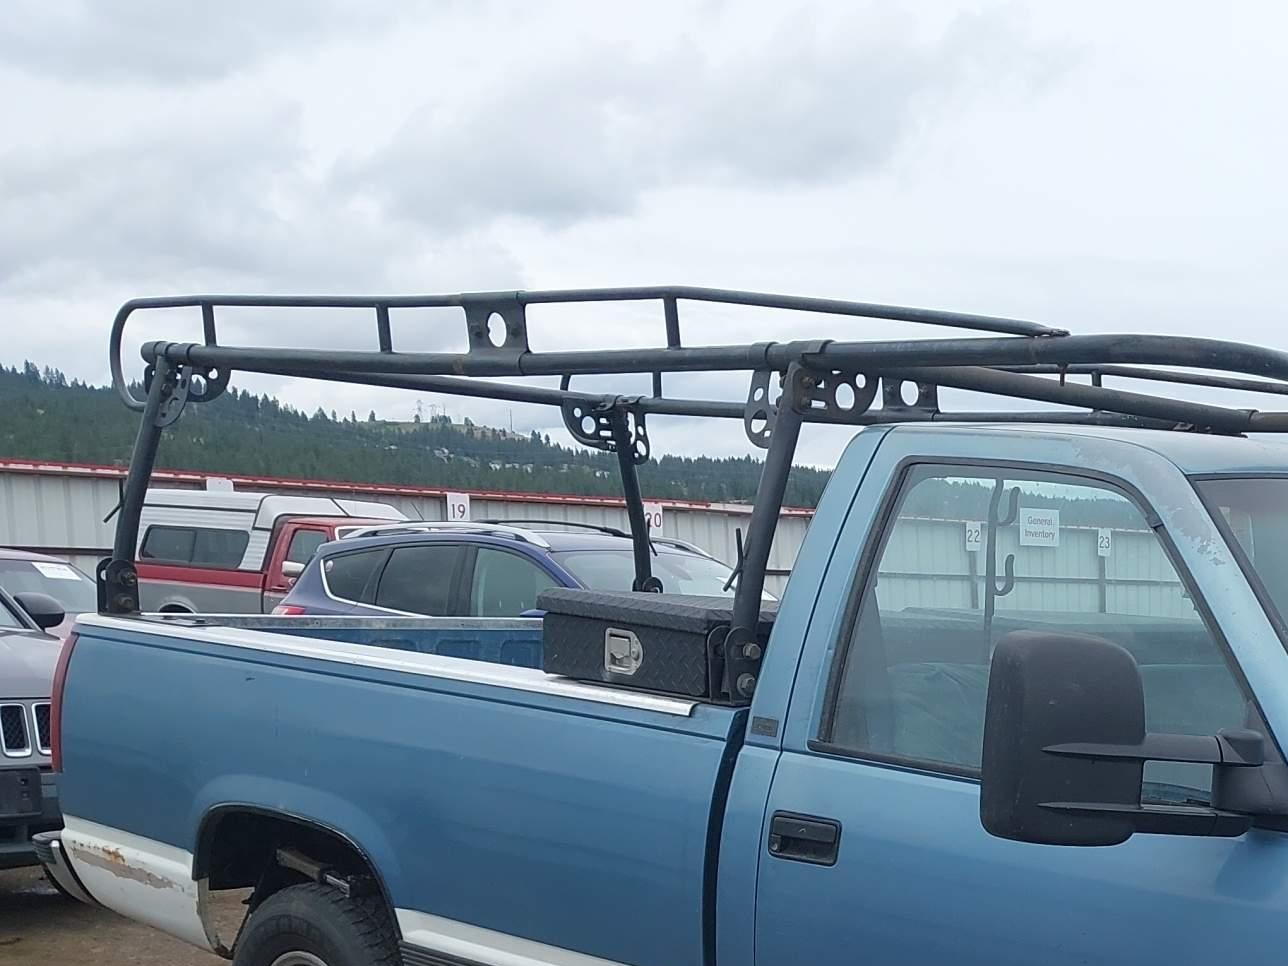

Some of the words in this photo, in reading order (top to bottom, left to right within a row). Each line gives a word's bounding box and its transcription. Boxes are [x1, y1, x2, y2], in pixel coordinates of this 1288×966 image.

[451, 503, 466, 519] 19
[644, 512, 662, 528] 20
[1027, 515, 1053, 526] General
[967, 529, 981, 543] 22
[1024, 529, 1056, 541] Inventory
[1099, 535, 1110, 549] 23
